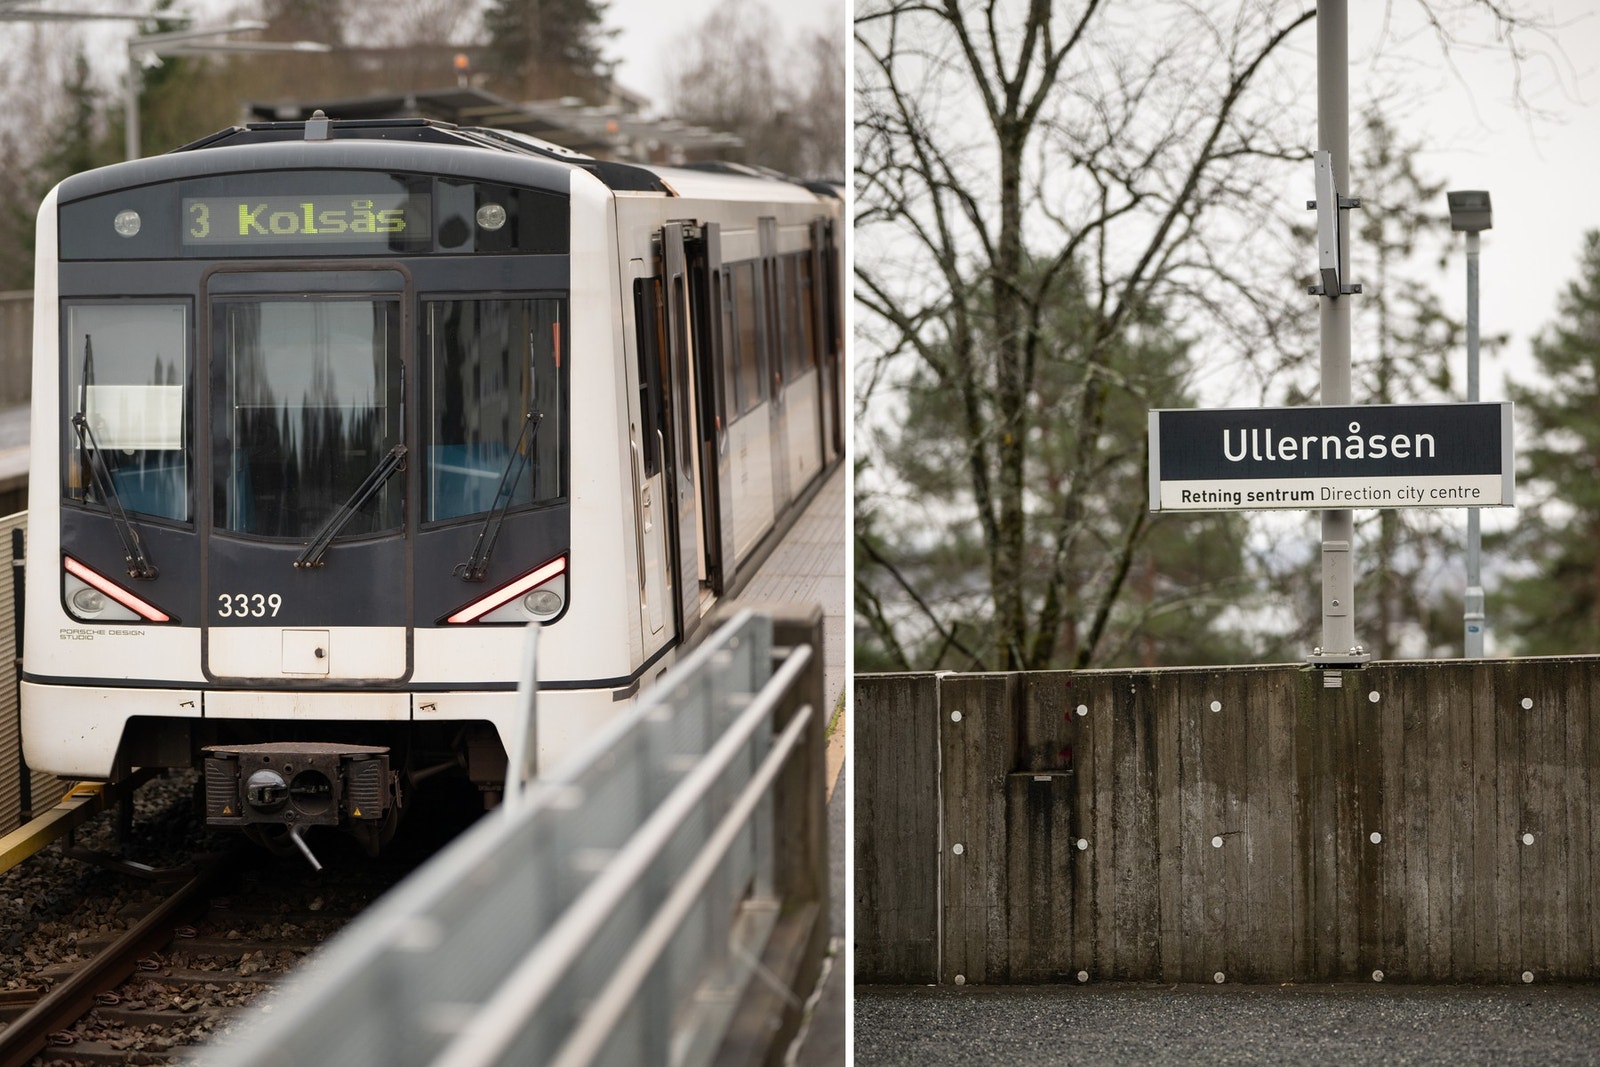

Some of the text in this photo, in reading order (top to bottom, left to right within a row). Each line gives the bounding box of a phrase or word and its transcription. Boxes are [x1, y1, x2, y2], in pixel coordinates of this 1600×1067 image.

[190, 199, 407, 238] 3 Kolsås
[1223, 421, 1435, 462] Ullernåsen
[1181, 485, 1480, 505] Retning sentrum Direction city centre
[218, 593, 282, 618] 3339
[60, 628, 106, 636] PORSCHE
